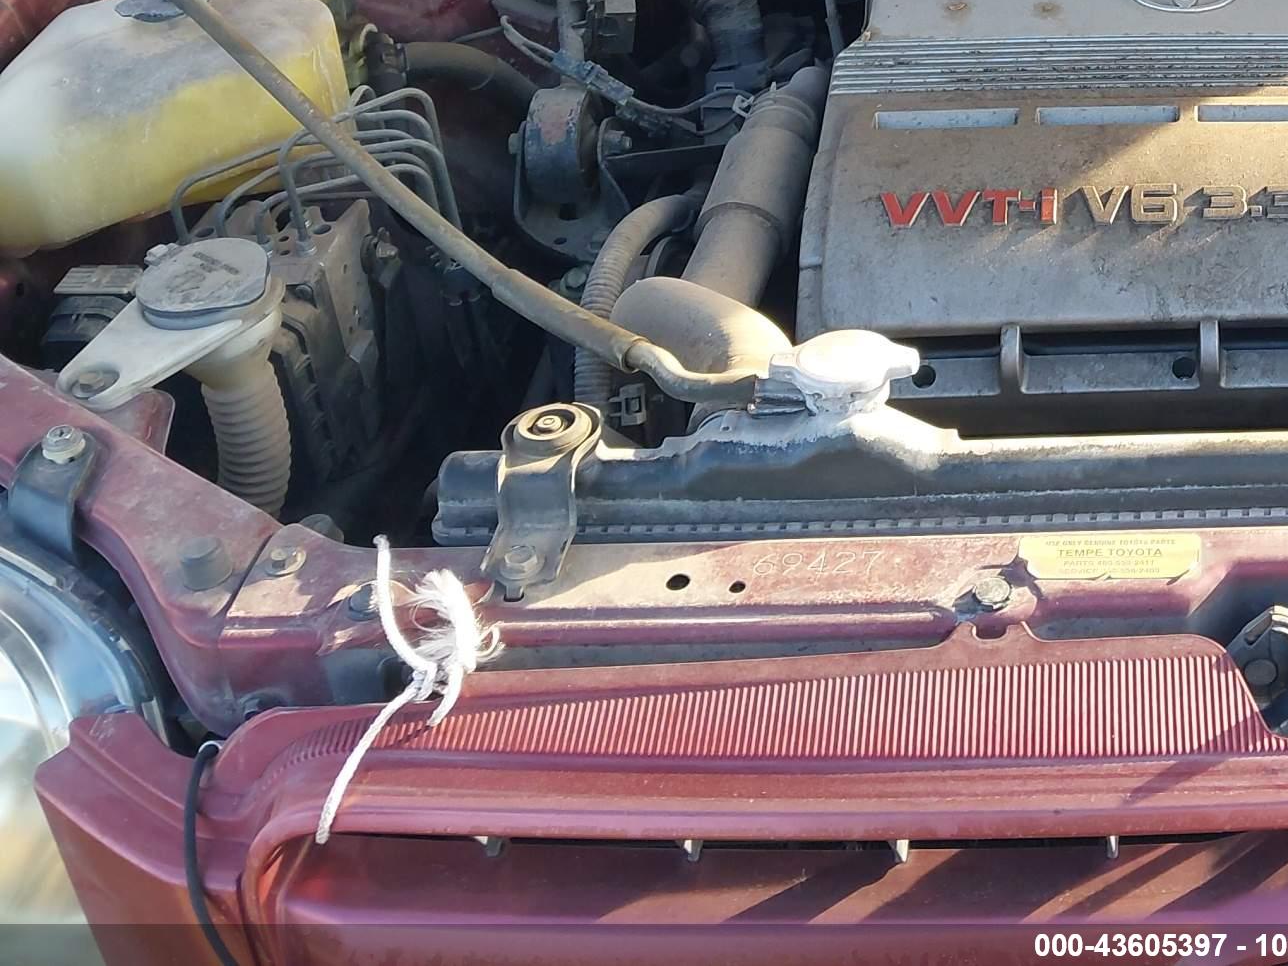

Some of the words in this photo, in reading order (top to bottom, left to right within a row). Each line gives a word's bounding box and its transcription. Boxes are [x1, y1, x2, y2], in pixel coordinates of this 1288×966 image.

[1080, 183, 1178, 224] V6
[752, 547, 883, 577] 69427
[1057, 548, 1105, 557] TEMPE
[1108, 547, 1163, 557] TOYOTA
